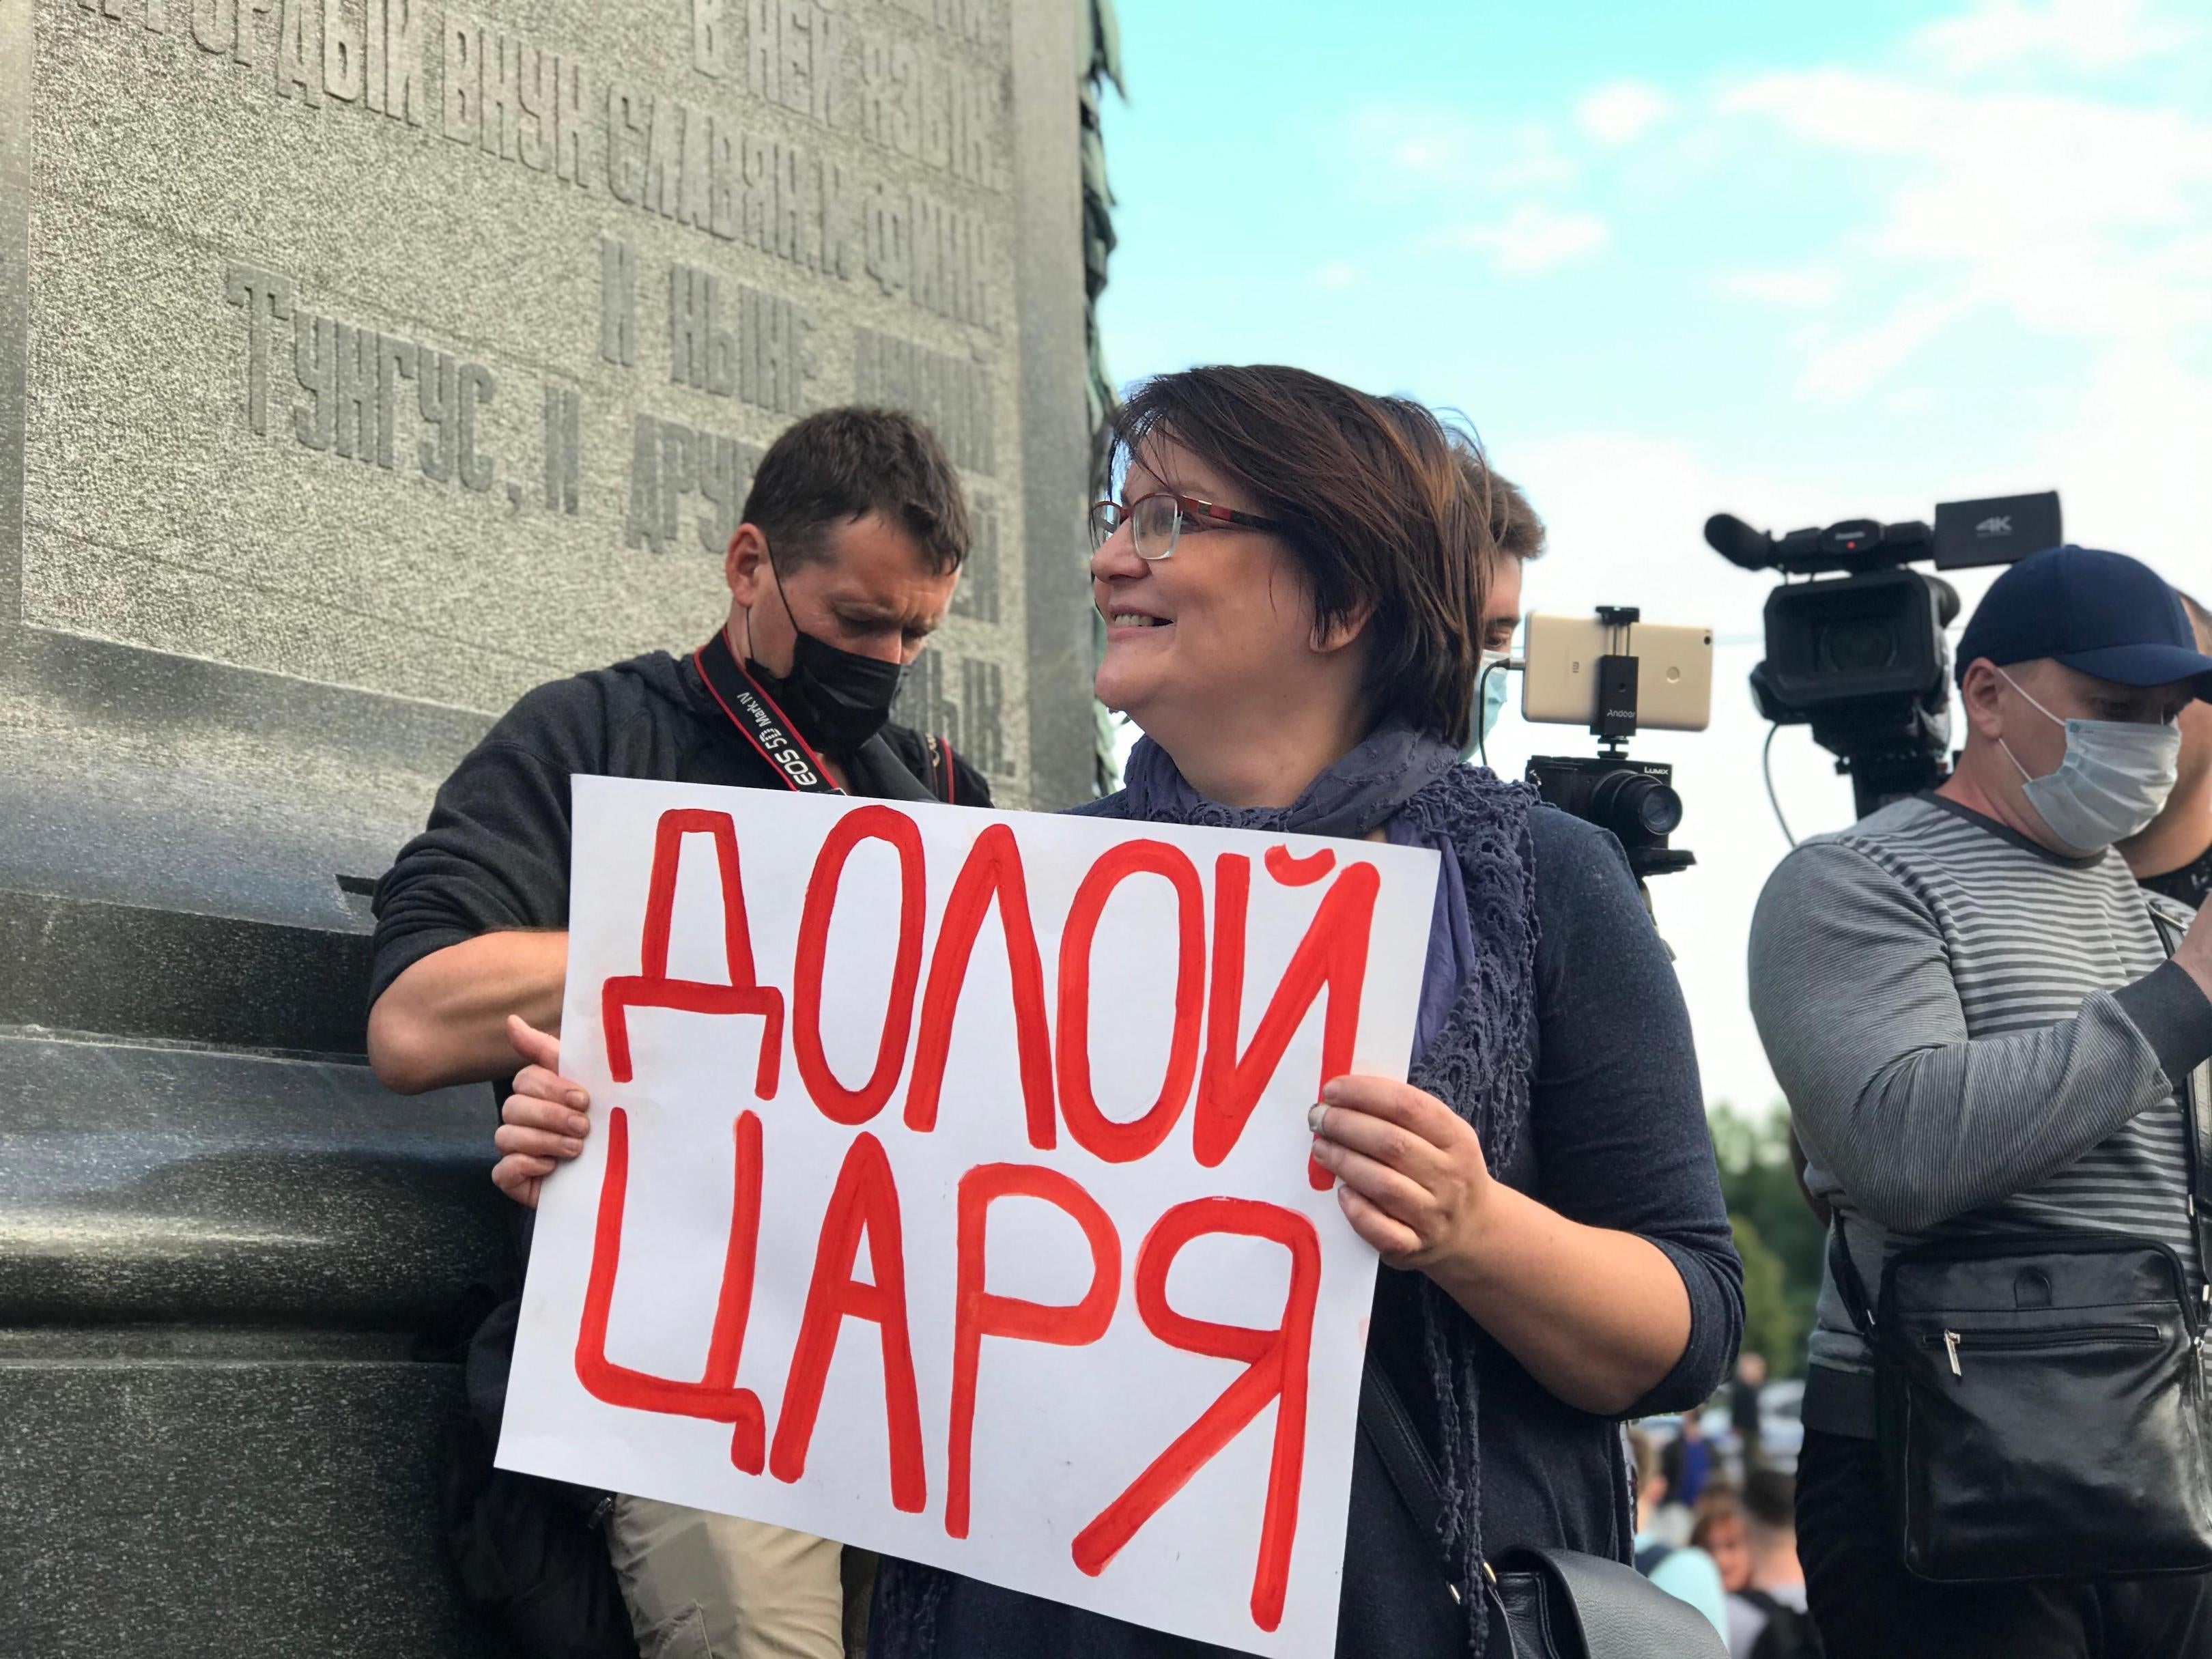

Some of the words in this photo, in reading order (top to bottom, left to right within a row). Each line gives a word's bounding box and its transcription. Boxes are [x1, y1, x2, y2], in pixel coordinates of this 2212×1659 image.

[442, 9, 590, 189] ВНУК
[819, 158, 852, 281] И
[601, 238, 635, 367] И
[670, 262, 817, 419] НЫНЕ
[227, 259, 522, 516] ТУНГУС,
[545, 386, 580, 515] И
[1976, 515, 2013, 533] 4K
[737, 692, 753, 705] IV
[747, 700, 772, 727] Mark
[1606, 709, 1636, 718] Andoer
[759, 728, 787, 749] 5D
[774, 750, 817, 785] EOS
[1644, 766, 1669, 775] LUMIX
[602, 805, 1381, 1191] ДОЛОЙ
[575, 1108, 1322, 1632] ЦАРЯ
